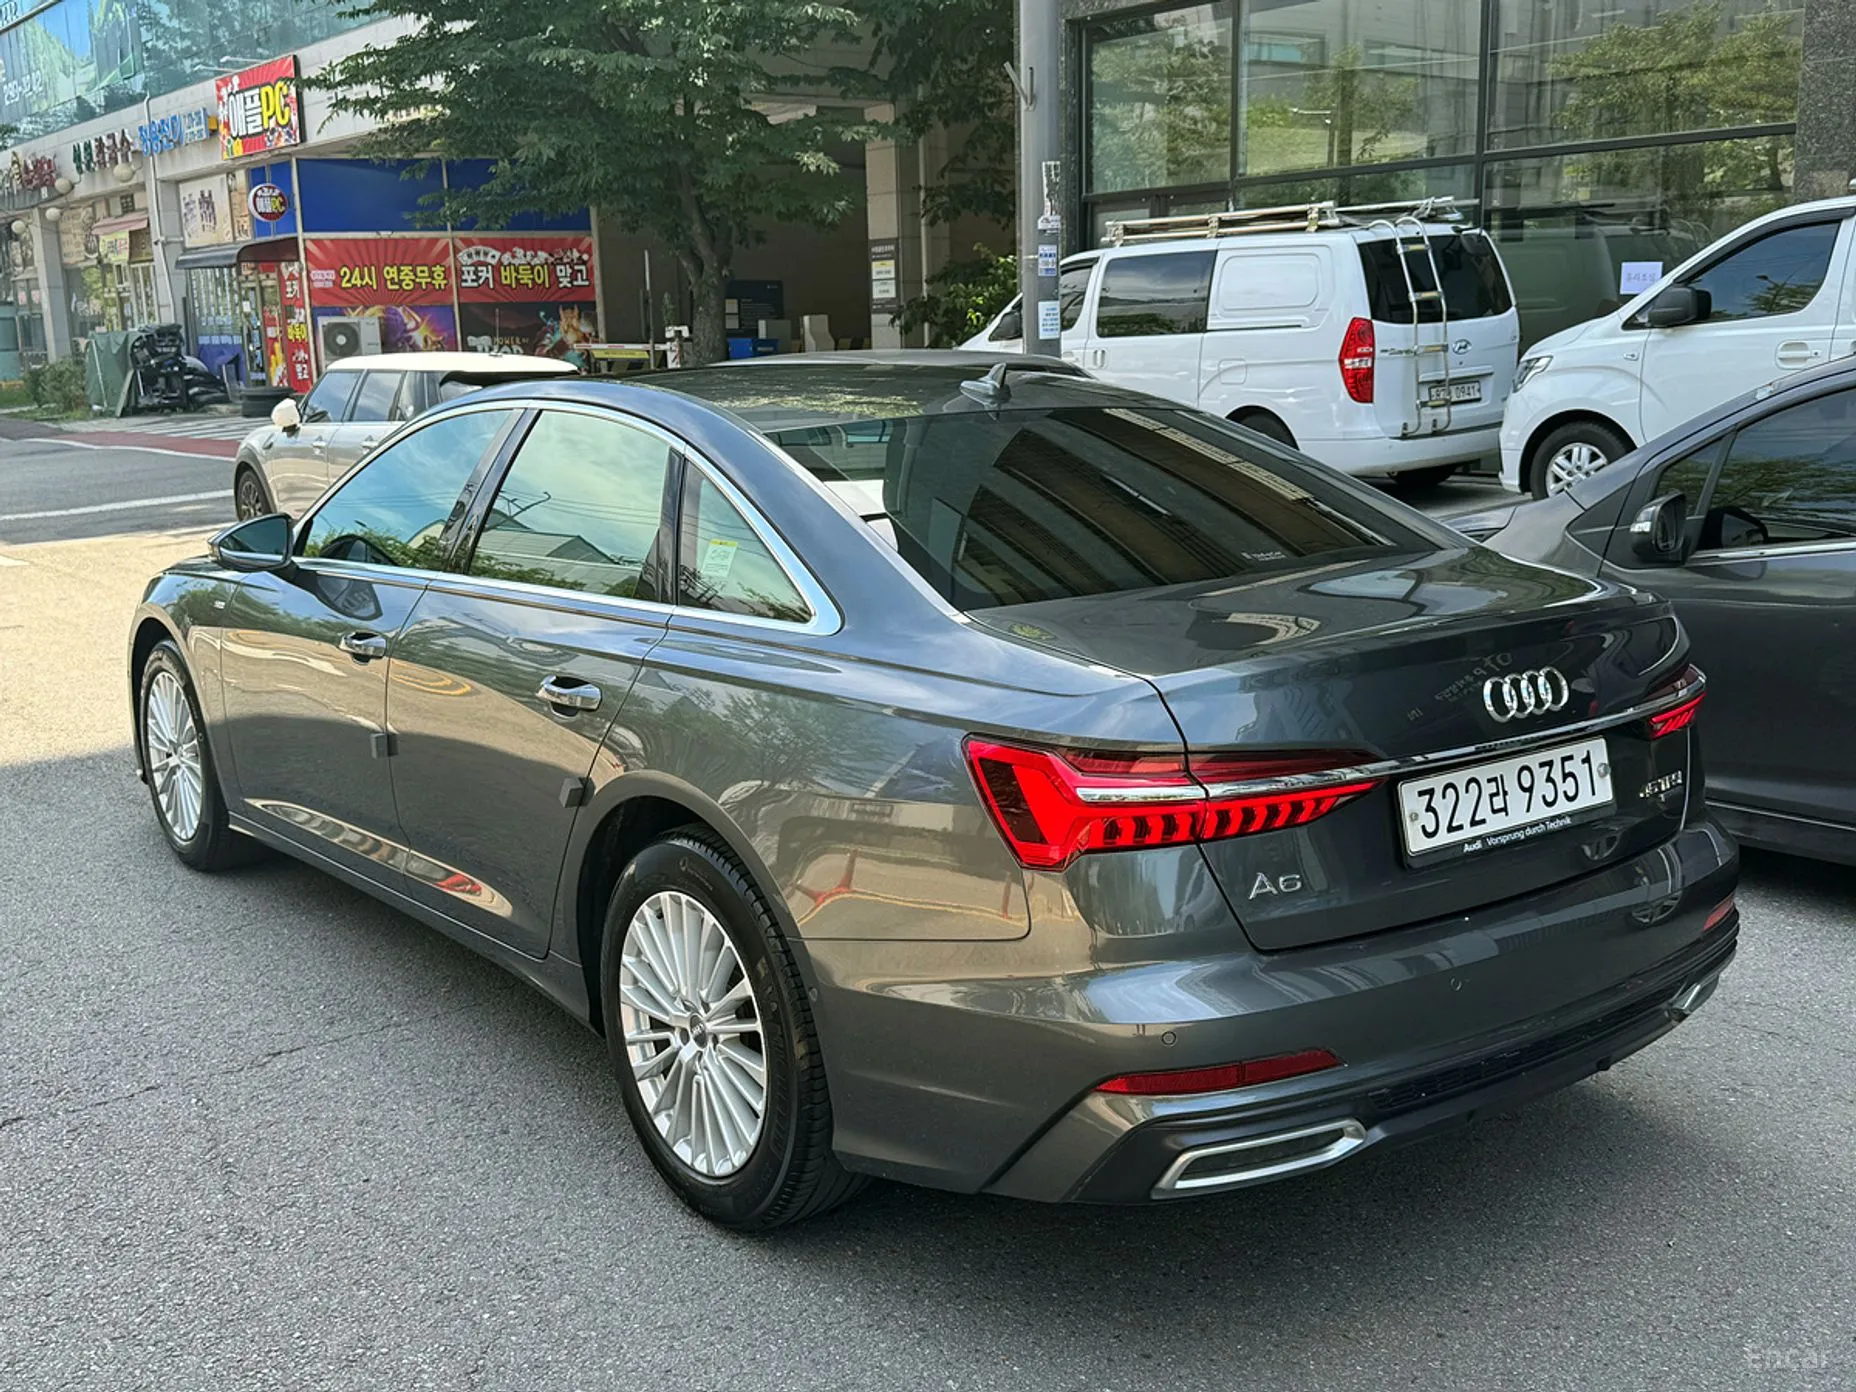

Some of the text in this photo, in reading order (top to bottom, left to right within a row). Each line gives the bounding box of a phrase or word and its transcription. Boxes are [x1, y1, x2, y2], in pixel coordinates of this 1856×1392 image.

[228, 81, 291, 137] 애플PC
[340, 265, 377, 290] 24시
[383, 265, 447, 291] 연중무휴
[461, 264, 590, 288] 포커 바둑이 맞고
[1417, 750, 1597, 839] 322라 9351
[1463, 816, 1572, 853] Audi Vorsprung durch Technik
[1248, 872, 1302, 900] A6
